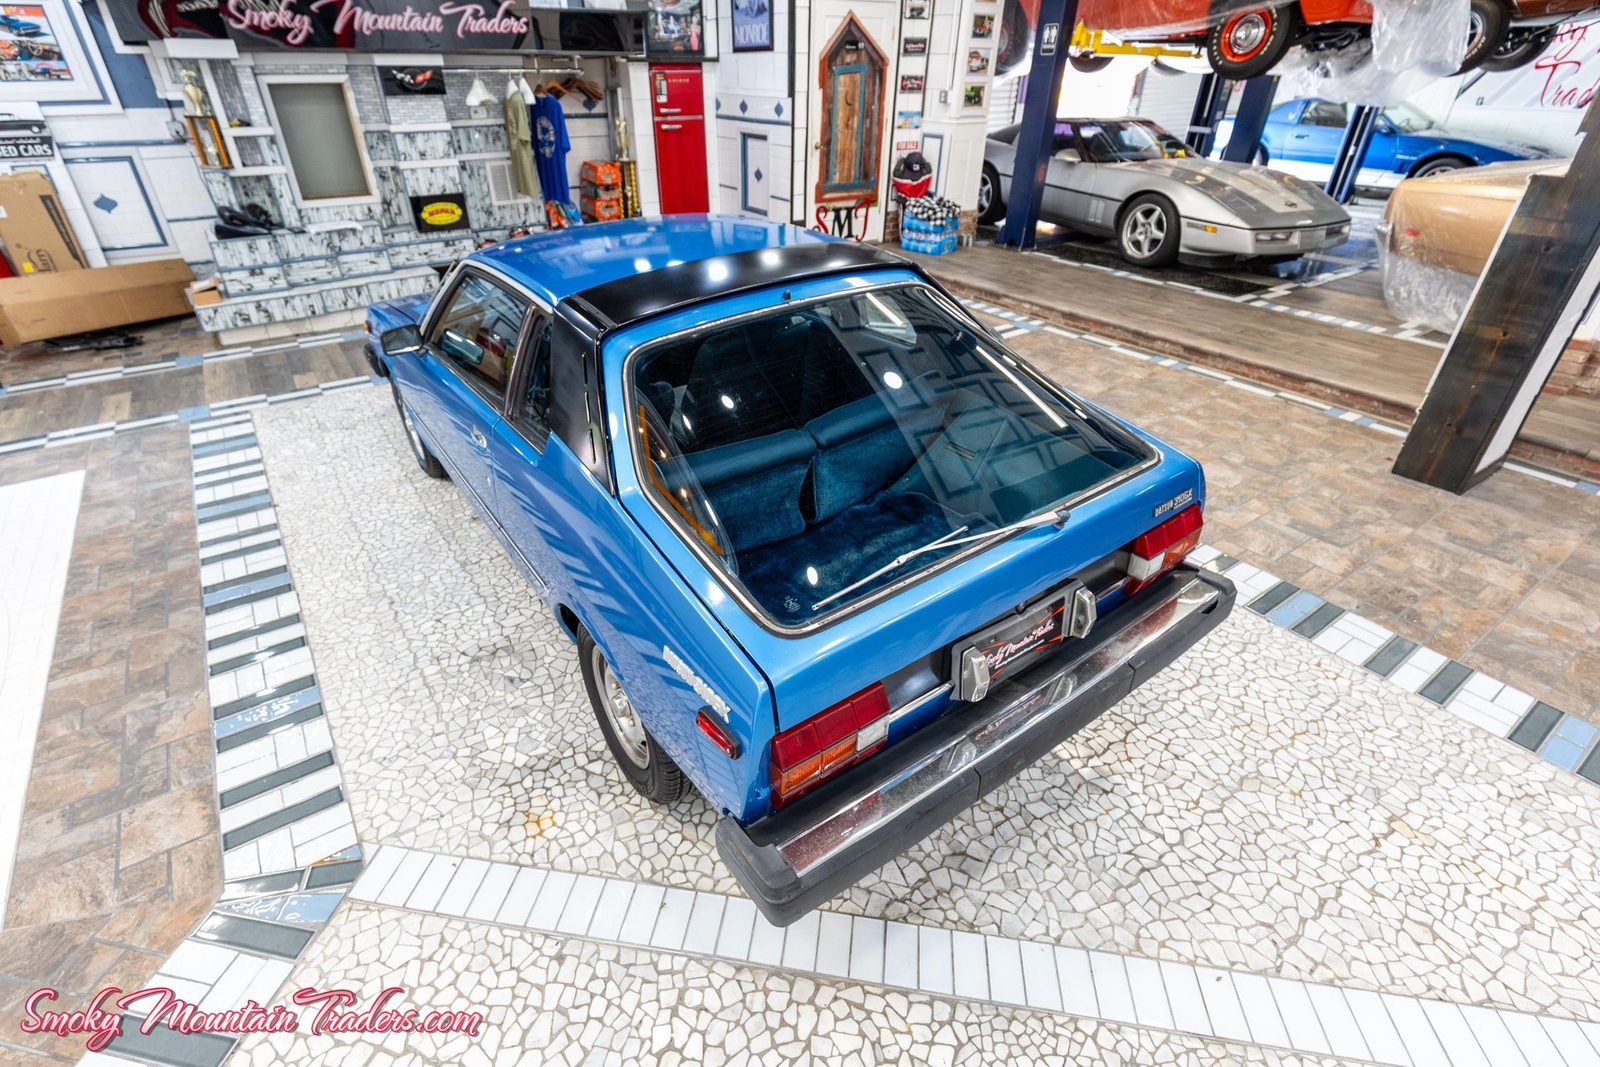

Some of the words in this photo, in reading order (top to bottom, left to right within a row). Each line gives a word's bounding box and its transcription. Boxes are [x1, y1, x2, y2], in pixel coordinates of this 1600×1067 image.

[228, 0, 314, 45] Smoky
[310, 0, 444, 36] Mountain
[439, 0, 529, 38] Traders
[734, 23, 769, 44] MONROE
[0, 144, 19, 158] ED
[19, 143, 53, 157] CARS
[812, 198, 877, 242] SMT
[1154, 500, 1174, 518] DATSUN
